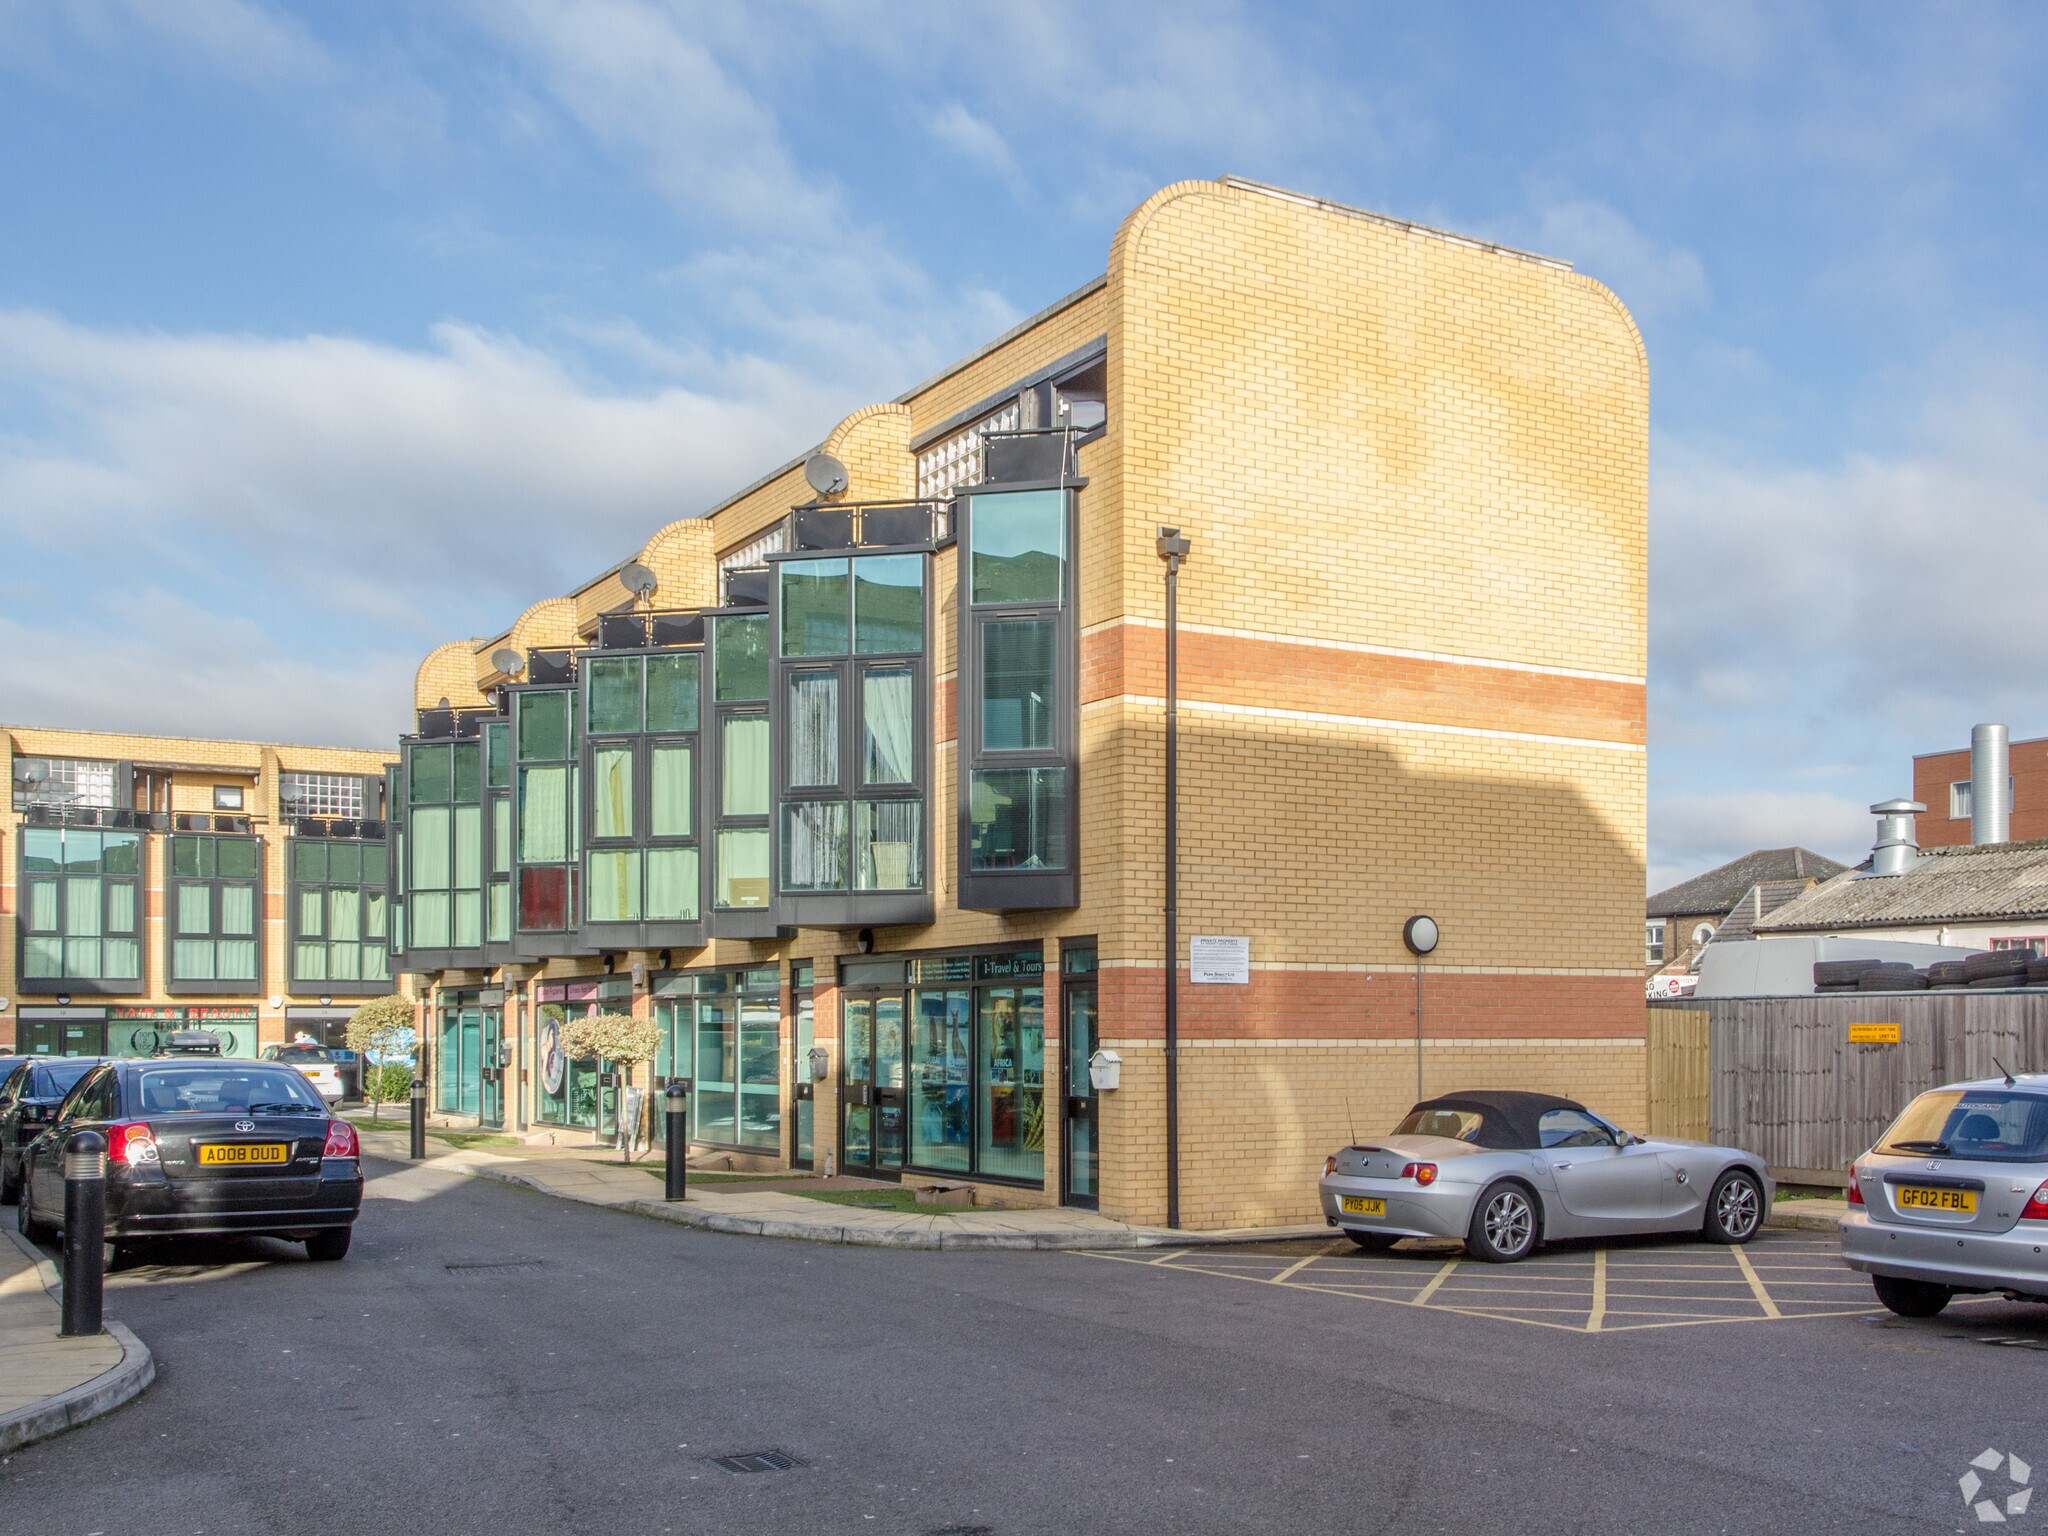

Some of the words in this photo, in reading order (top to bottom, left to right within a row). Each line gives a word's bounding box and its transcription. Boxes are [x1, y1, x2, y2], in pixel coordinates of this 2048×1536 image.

[984, 958, 1011, 974] i-Travel
[1013, 960, 1019, 972] &
[1021, 960, 1042, 972] Tours
[1646, 989, 1668, 999] KING
[115, 1008, 154, 1018] HAIR
[164, 1008, 174, 1019] &
[189, 1008, 251, 1018] BEAUTY
[993, 1058, 1013, 1068] AFRICA
[250, 1147, 280, 1161] OUD
[1344, 1198, 1363, 1210] PY05
[1365, 1200, 1381, 1213] JJK
[1902, 1190, 1938, 1206] GF02
[1941, 1192, 1969, 1209] FBL
